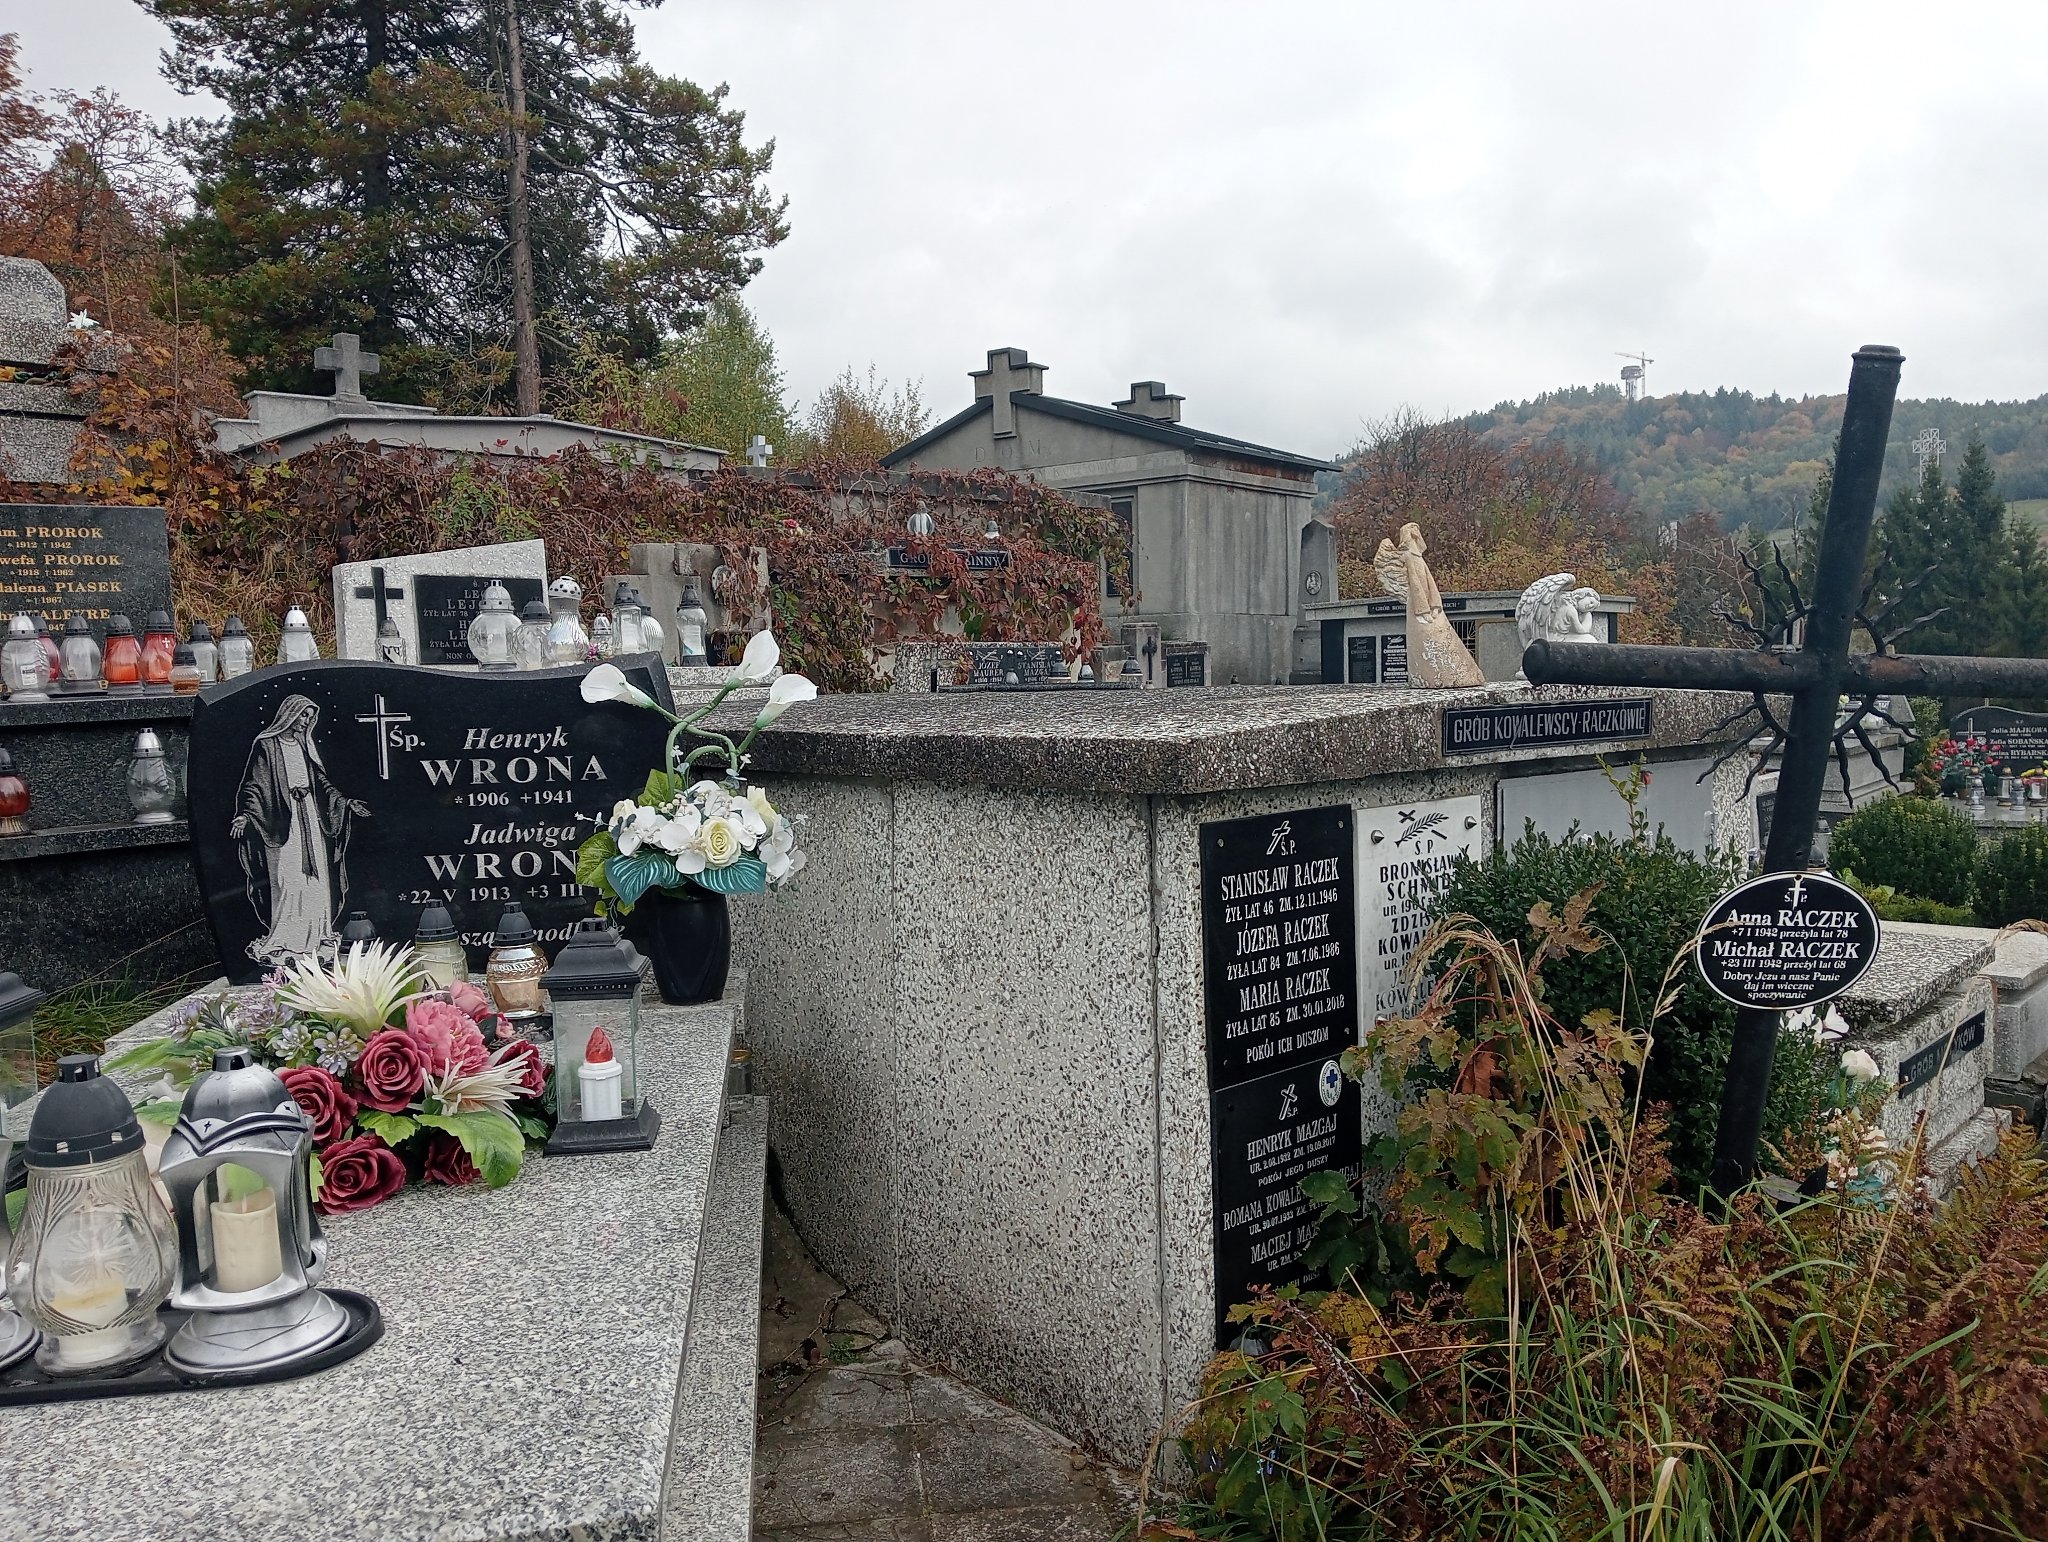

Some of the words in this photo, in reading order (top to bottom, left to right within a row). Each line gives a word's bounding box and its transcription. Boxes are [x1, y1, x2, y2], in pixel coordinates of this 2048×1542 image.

[25, 527, 103, 538] PROROK
[43, 555, 122, 566] PROROK
[55, 582, 122, 593] PIASEK
[389, 725, 426, 752] Śp.
[463, 726, 568, 754] Henryk
[1454, 714, 1490, 743] GRÓB
[420, 755, 608, 786] WRONA
[464, 821, 576, 848] Jadwiga
[424, 850, 577, 882] WRON
[1221, 866, 1289, 902] STANISŁAW
[1294, 857, 1340, 888] RACZEK
[443, 889, 457, 903] V
[470, 886, 511, 901] 1913
[1225, 904, 1243, 924] ŻYŁ
[1245, 902, 1261, 920] LAT
[1263, 899, 1274, 916] 46
[1279, 896, 1294, 913] ZM.
[1295, 887, 1338, 910] 12.11.1946
[1726, 909, 1772, 926] Anna
[1778, 909, 1860, 928] RACZEK
[1236, 922, 1280, 956] JÓZEFA
[1284, 913, 1330, 946] RACZEK
[1755, 927, 1778, 937] 1942
[1821, 930, 1833, 938] lat
[1836, 929, 1849, 939] 78
[1712, 940, 1775, 957] Michał
[1780, 941, 1861, 959] RACZEK
[1721, 959, 1740, 968] +23
[1743, 959, 1756, 968] III
[1758, 958, 1782, 968] 1942
[1819, 960, 1831, 969] lat
[1833, 959, 1847, 969] 68
[1227, 961, 1250, 981] ŻYŁA
[1251, 957, 1268, 976] LAT
[1270, 955, 1281, 971] 84
[1286, 950, 1302, 967] ZM.
[1722, 970, 1753, 983] Dobry
[1755, 971, 1778, 981] Jezu
[1812, 972, 1840, 982] Panie
[1240, 979, 1282, 1013] MARIA
[1285, 967, 1331, 1001] RACZEK
[1744, 981, 1759, 991] daj
[1761, 982, 1775, 990] im
[1777, 982, 1815, 991] wieczne
[1747, 991, 1807, 1000] spoczywanie
[1226, 1019, 1249, 1040] ŻYŁA
[1251, 1014, 1268, 1032] LAT
[1270, 1012, 1281, 1028] 85
[1286, 1005, 1301, 1023] ZM.
[1302, 993, 1345, 1018] 30.01.2018
[1246, 1038, 1274, 1064] POKÓJ
[1278, 1036, 1293, 1055] ICH
[1297, 1026, 1330, 1050] DUSZOM
[1247, 1128, 1293, 1161] HENRYK
[1295, 1112, 1338, 1144] MAZGAJ
[1258, 1171, 1283, 1188] POKÓJ
[1284, 1163, 1304, 1178] JEGO
[1307, 1154, 1329, 1169] DUSZY
[1222, 1199, 1263, 1231] ROMANA
[1250, 1230, 1292, 1265] MACIEJ
